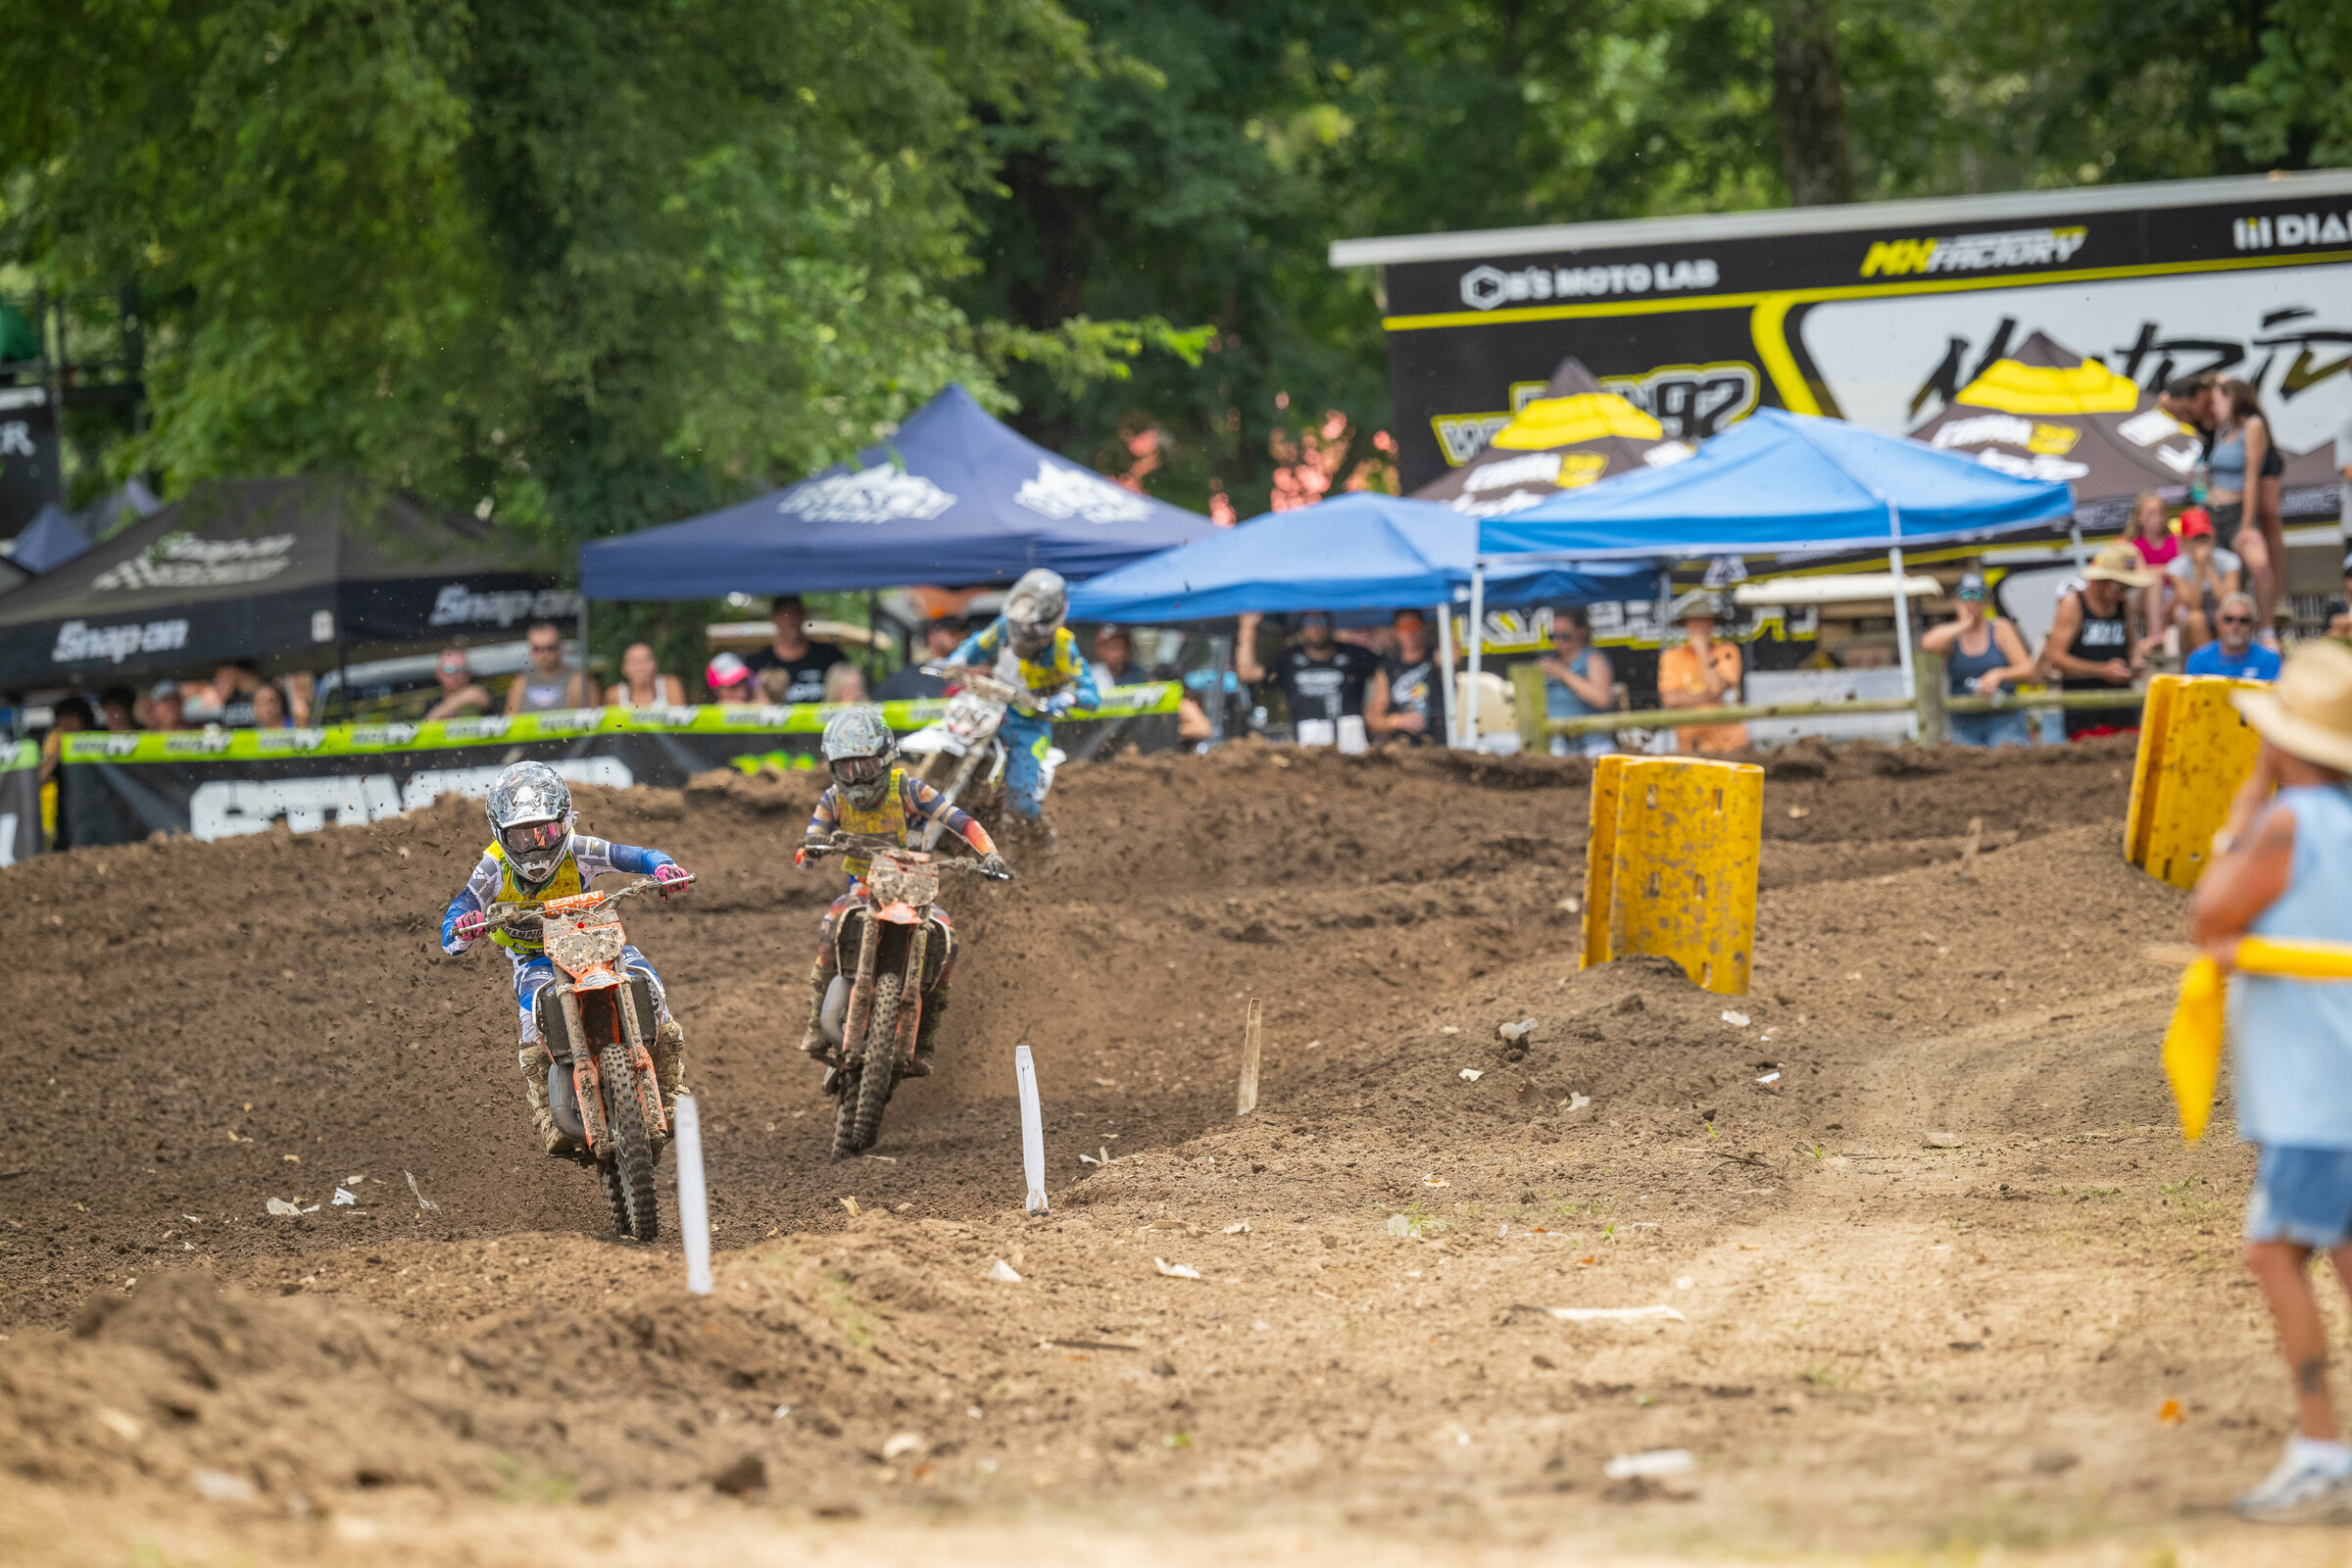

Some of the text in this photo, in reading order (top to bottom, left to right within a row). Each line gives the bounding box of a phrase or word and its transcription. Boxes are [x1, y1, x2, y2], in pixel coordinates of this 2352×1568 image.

[2275, 209, 2352, 247] DIA
[1553, 262, 1653, 299] MOTO
[1653, 258, 1720, 291] LAB
[52, 619, 189, 664] Snap-on
